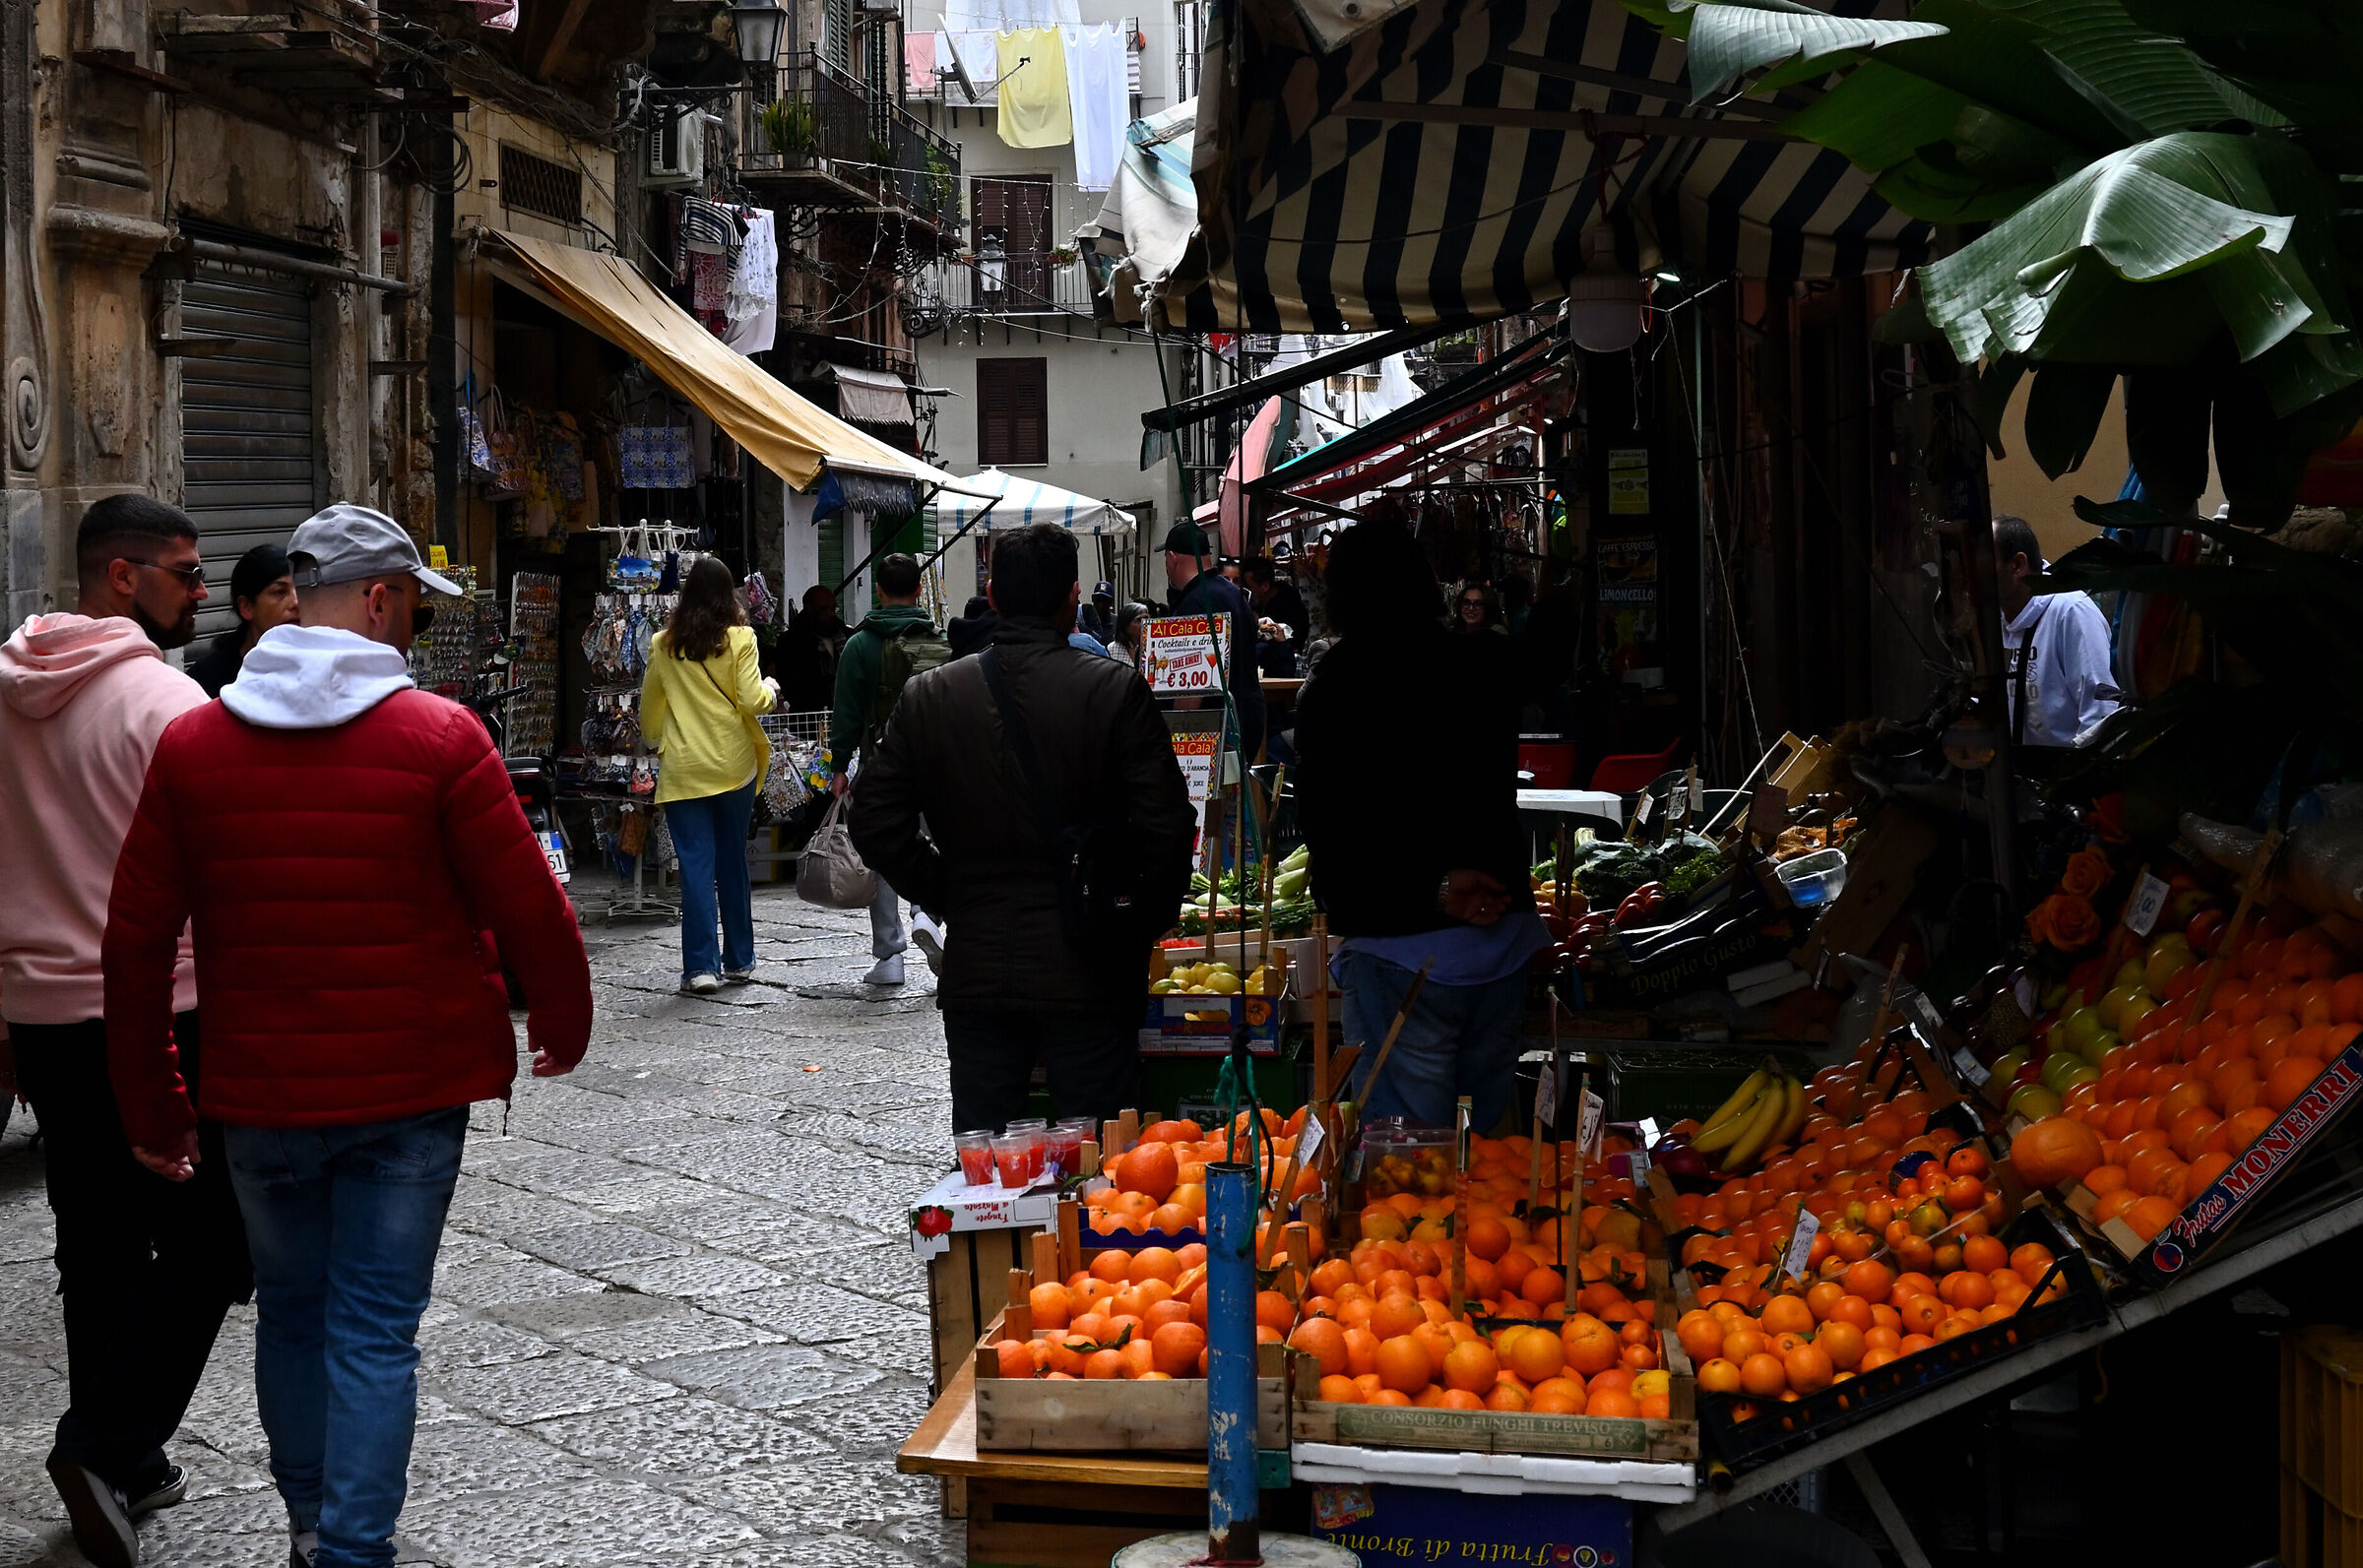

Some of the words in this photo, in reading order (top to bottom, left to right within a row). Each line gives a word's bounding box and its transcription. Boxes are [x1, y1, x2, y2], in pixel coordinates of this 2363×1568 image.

[1599, 588, 1654, 601] LIMONCELLO
[1152, 624, 1166, 637] Al
[1169, 623, 1193, 636] Cala
[1196, 621, 1222, 635] Caa
[1158, 638, 1190, 649] Cocktails
[1172, 659, 1184, 670] TAKE
[1184, 654, 1200, 668] AWAY
[1168, 672, 1176, 688] €
[1179, 670, 1208, 689] 3,00
[1173, 744, 1185, 755] ala
[1187, 742, 1211, 755] Cala
[1630, 958, 1699, 997] Doppio
[1702, 934, 1756, 972] Gusto
[2172, 1194, 2227, 1248] Frutas
[2217, 1058, 2361, 1201] MONERRI
[1370, 1410, 1466, 1429] CONSORZIO
[1471, 1415, 1536, 1432] FUNGHI
[1540, 1419, 1612, 1435] TREVISO
[1424, 1538, 1450, 1563] di
[1461, 1540, 1554, 1567] Frutta
